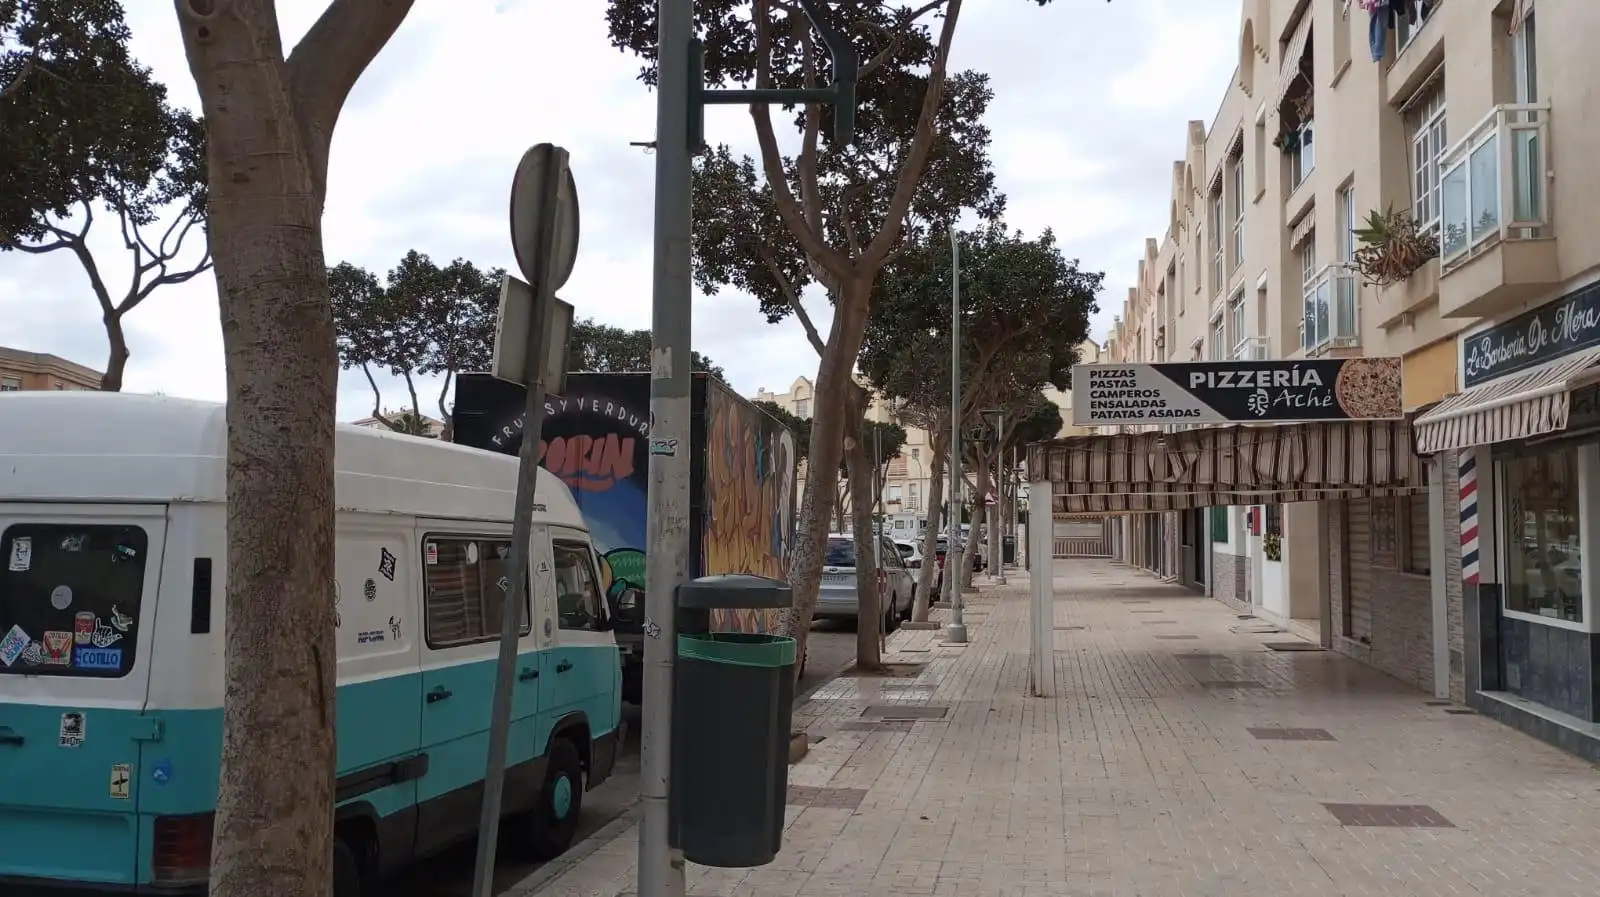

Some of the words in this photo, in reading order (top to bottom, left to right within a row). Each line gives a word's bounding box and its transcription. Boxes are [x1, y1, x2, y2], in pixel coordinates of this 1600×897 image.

[1528, 315, 1548, 355] De
[1090, 369, 1136, 379] PIZZAS
[1189, 364, 1323, 389] PIZZERÍA
[1090, 379, 1137, 389] PASTAS
[1090, 389, 1161, 399] CAMPEROS
[1272, 388, 1333, 408] Aché
[1090, 399, 1167, 409] ENSALADAS
[1090, 409, 1145, 420] PATATAS
[1147, 408, 1201, 418] ASADAS
[82, 652, 119, 666] COTILLO
